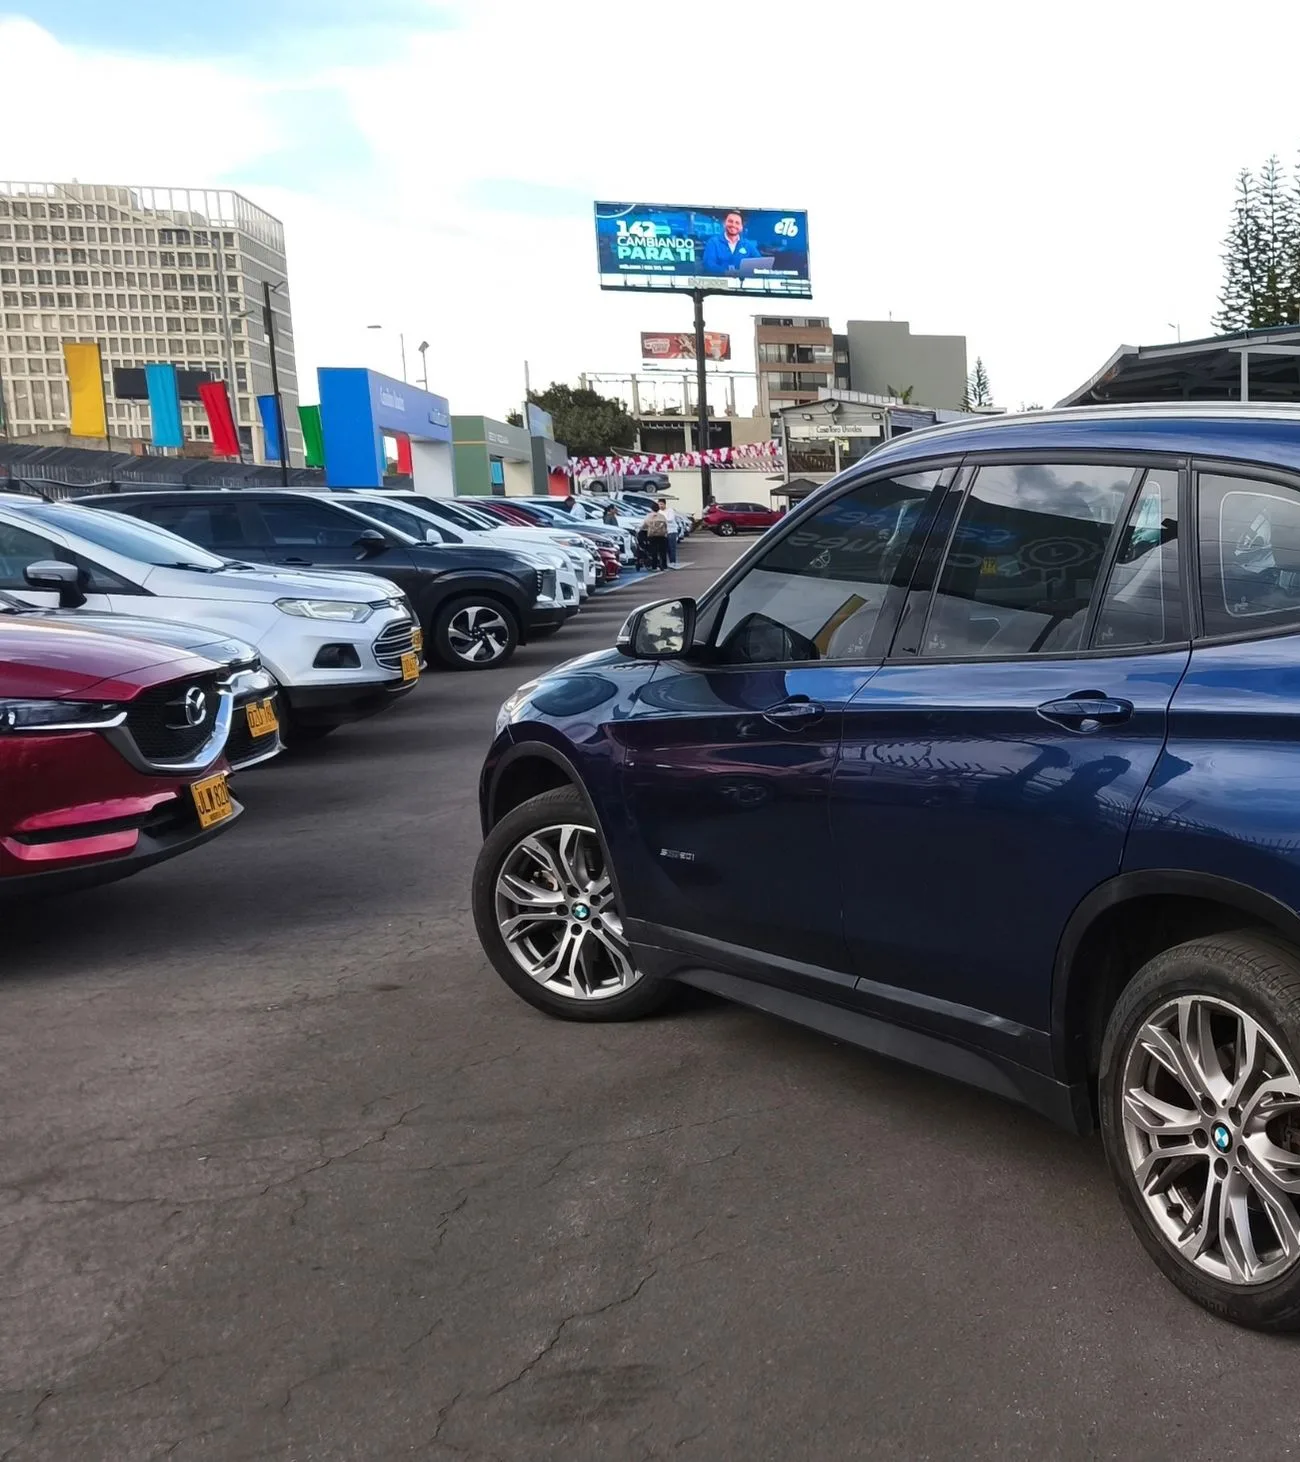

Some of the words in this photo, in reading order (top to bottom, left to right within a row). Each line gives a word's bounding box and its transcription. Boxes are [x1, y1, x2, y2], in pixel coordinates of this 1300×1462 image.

[617, 236, 694, 249] CAMBIANDO
[618, 246, 675, 261] PARA
[676, 247, 695, 262] TI
